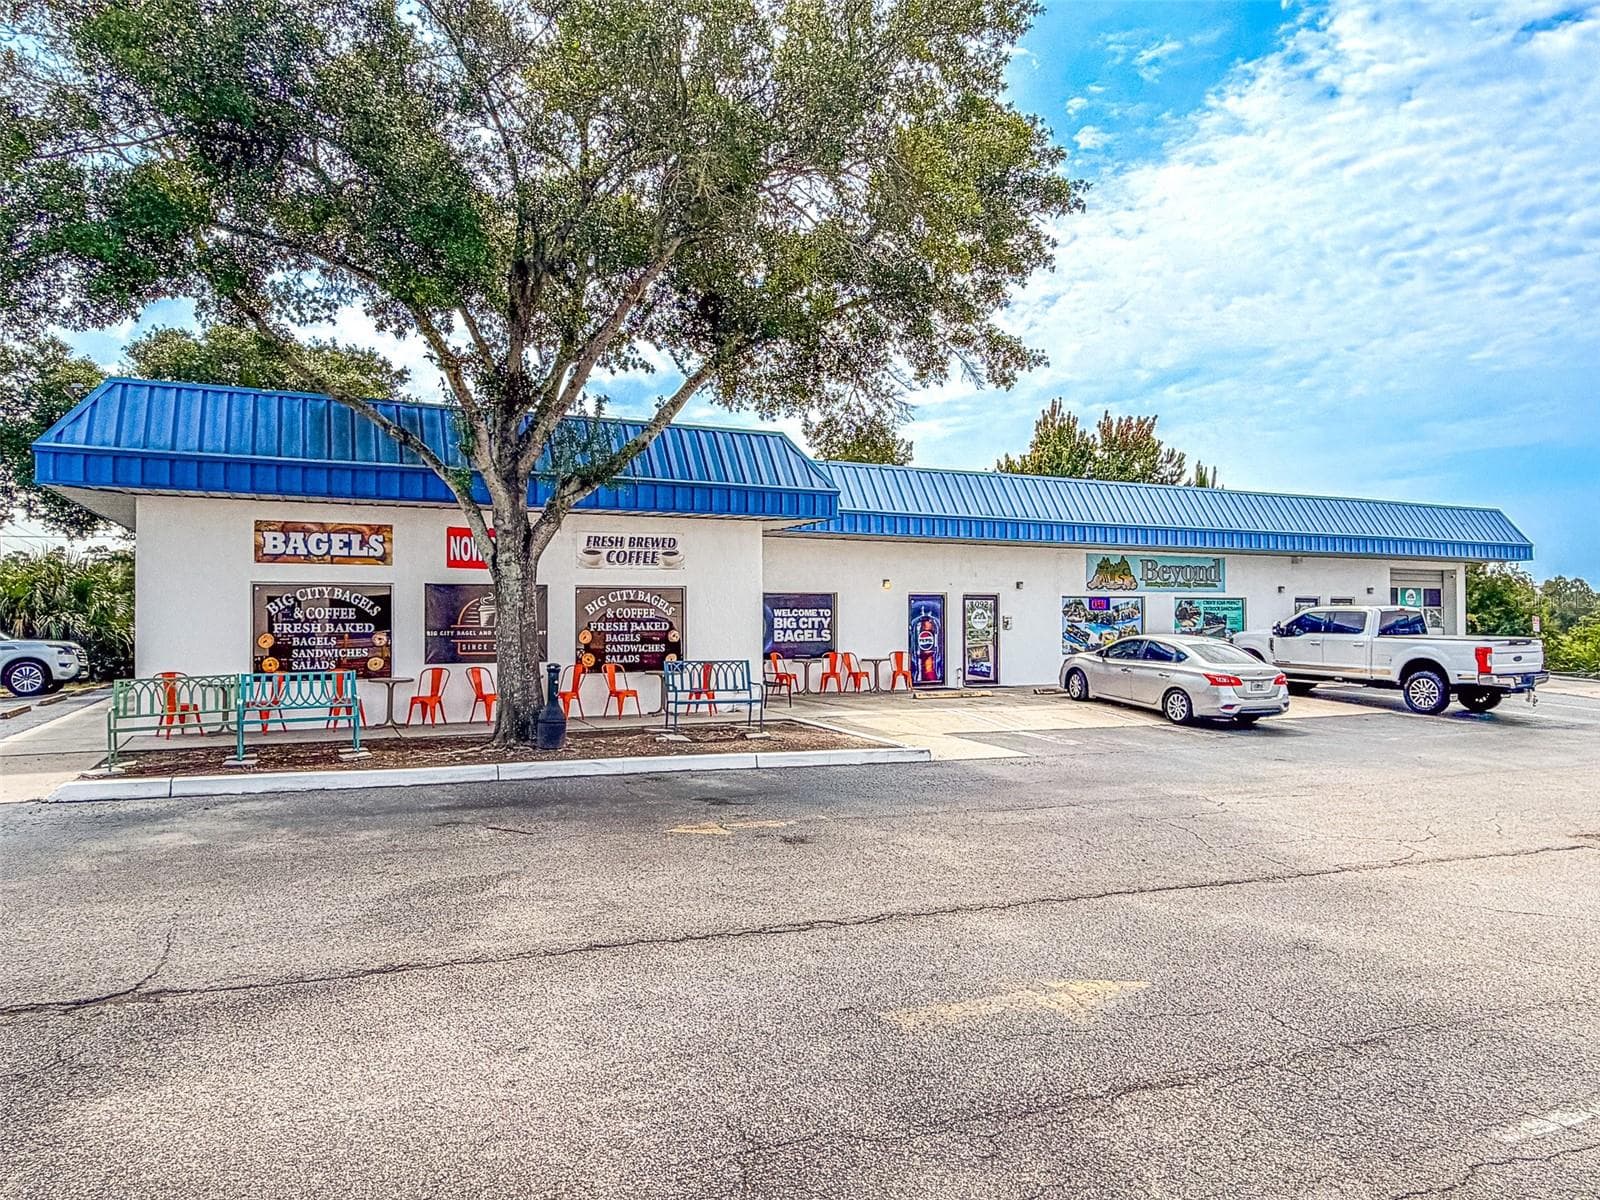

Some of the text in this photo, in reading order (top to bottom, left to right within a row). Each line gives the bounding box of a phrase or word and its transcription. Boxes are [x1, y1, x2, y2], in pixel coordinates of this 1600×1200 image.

[263, 532, 384, 557] BAGELS
[586, 535, 677, 549] FRESH BREWED
[606, 550, 659, 565] COFFEE
[1140, 558, 1221, 587] Beyond
[266, 586, 382, 617] BIG CITY BAGELS
[584, 589, 676, 617] BIG CITY BAGELS
[293, 607, 356, 620] & COFFEE
[606, 608, 656, 619] & COFFEE
[773, 608, 831, 617] WELCOME TO
[273, 623, 375, 634] FRESH BAKED
[589, 621, 670, 632] FRESH BAKED
[773, 617, 831, 629] BIG CITY
[605, 633, 641, 642] BAGELS
[773, 629, 832, 642] BAGELS
[292, 637, 337, 646] BAGELS
[462, 643, 488, 651] SINCE
[291, 648, 369, 658] SANDWICHES
[605, 644, 666, 653] SANDWICHES
[605, 654, 640, 663] SALADS
[291, 660, 336, 670] SALADS
